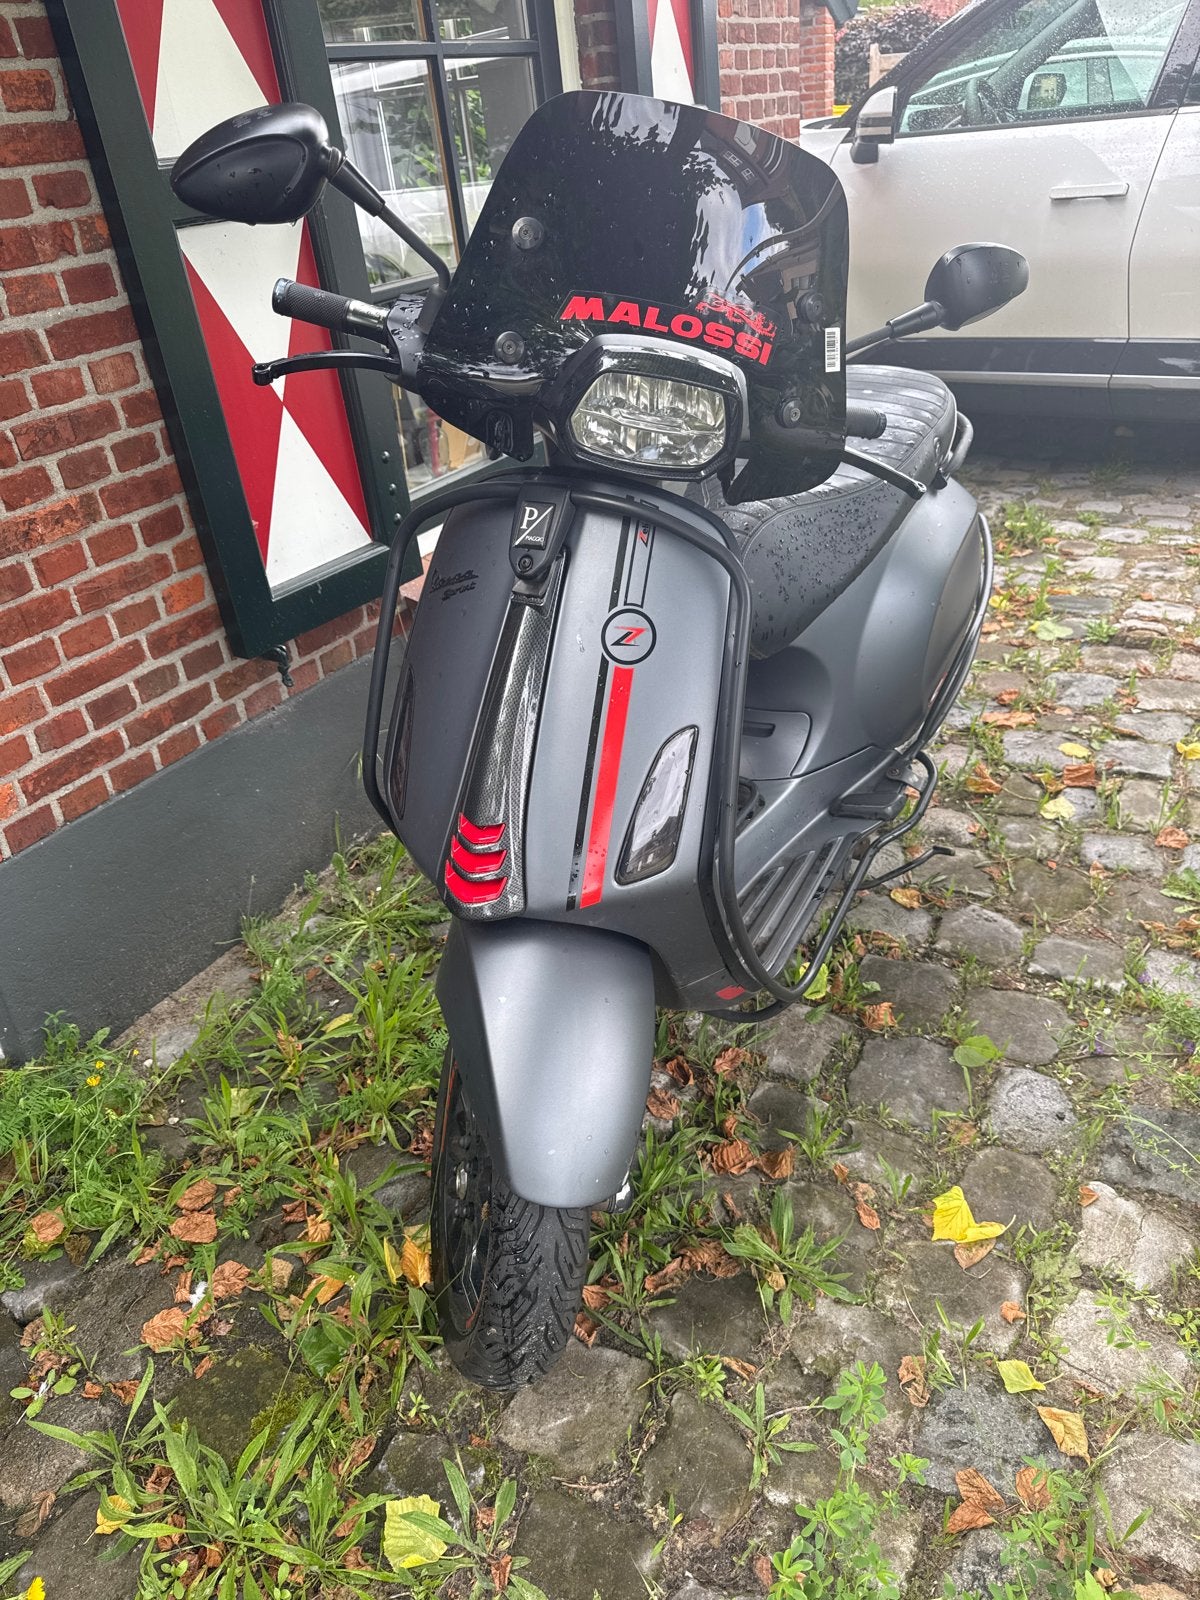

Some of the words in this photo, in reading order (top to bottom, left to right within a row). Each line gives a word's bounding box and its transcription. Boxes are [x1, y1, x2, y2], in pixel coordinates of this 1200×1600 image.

[560, 296, 773, 366] MALOSSI
[520, 506, 539, 529] P
[429, 567, 479, 593] Vespa
